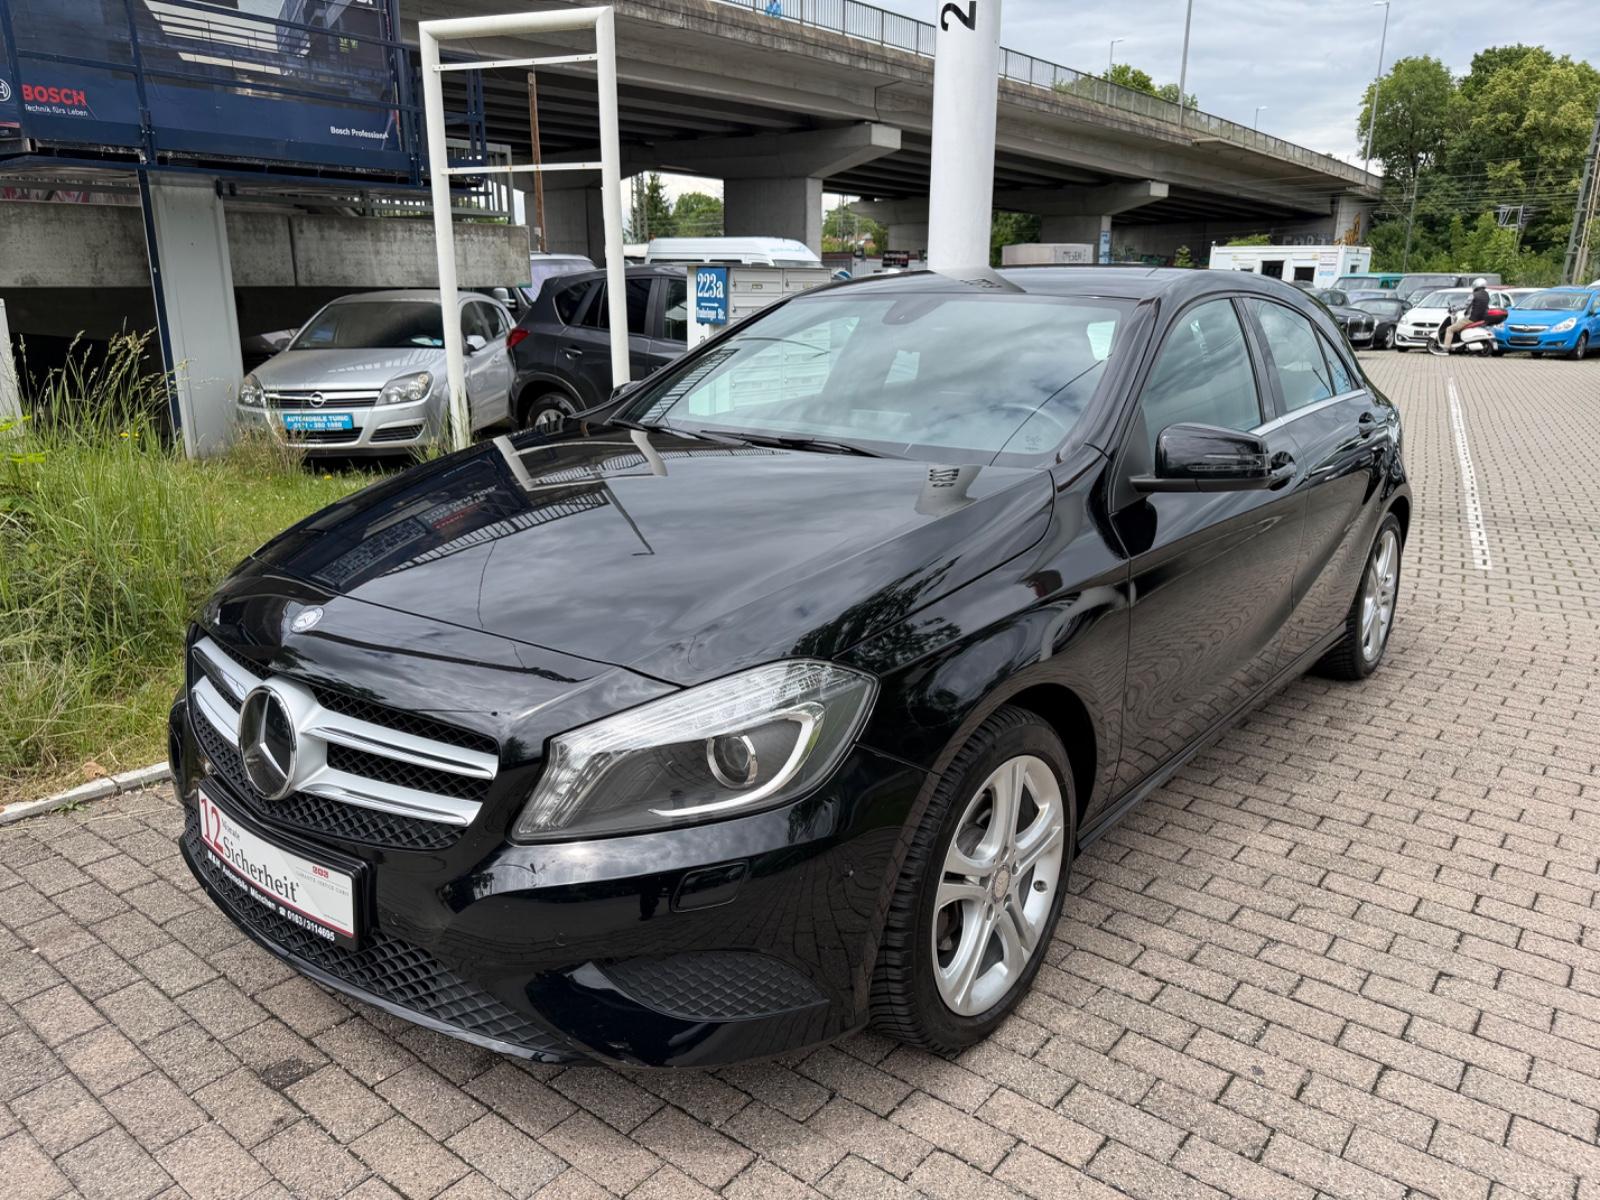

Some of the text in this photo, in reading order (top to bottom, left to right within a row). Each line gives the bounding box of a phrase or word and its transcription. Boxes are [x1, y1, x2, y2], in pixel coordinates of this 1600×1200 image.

[941, 1, 977, 31] 2
[22, 84, 87, 107] BOSCH
[25, 104, 88, 117] Technik fürs Leben
[330, 126, 350, 136] Bosch
[697, 273, 724, 298] 223a
[201, 798, 224, 854] 12
